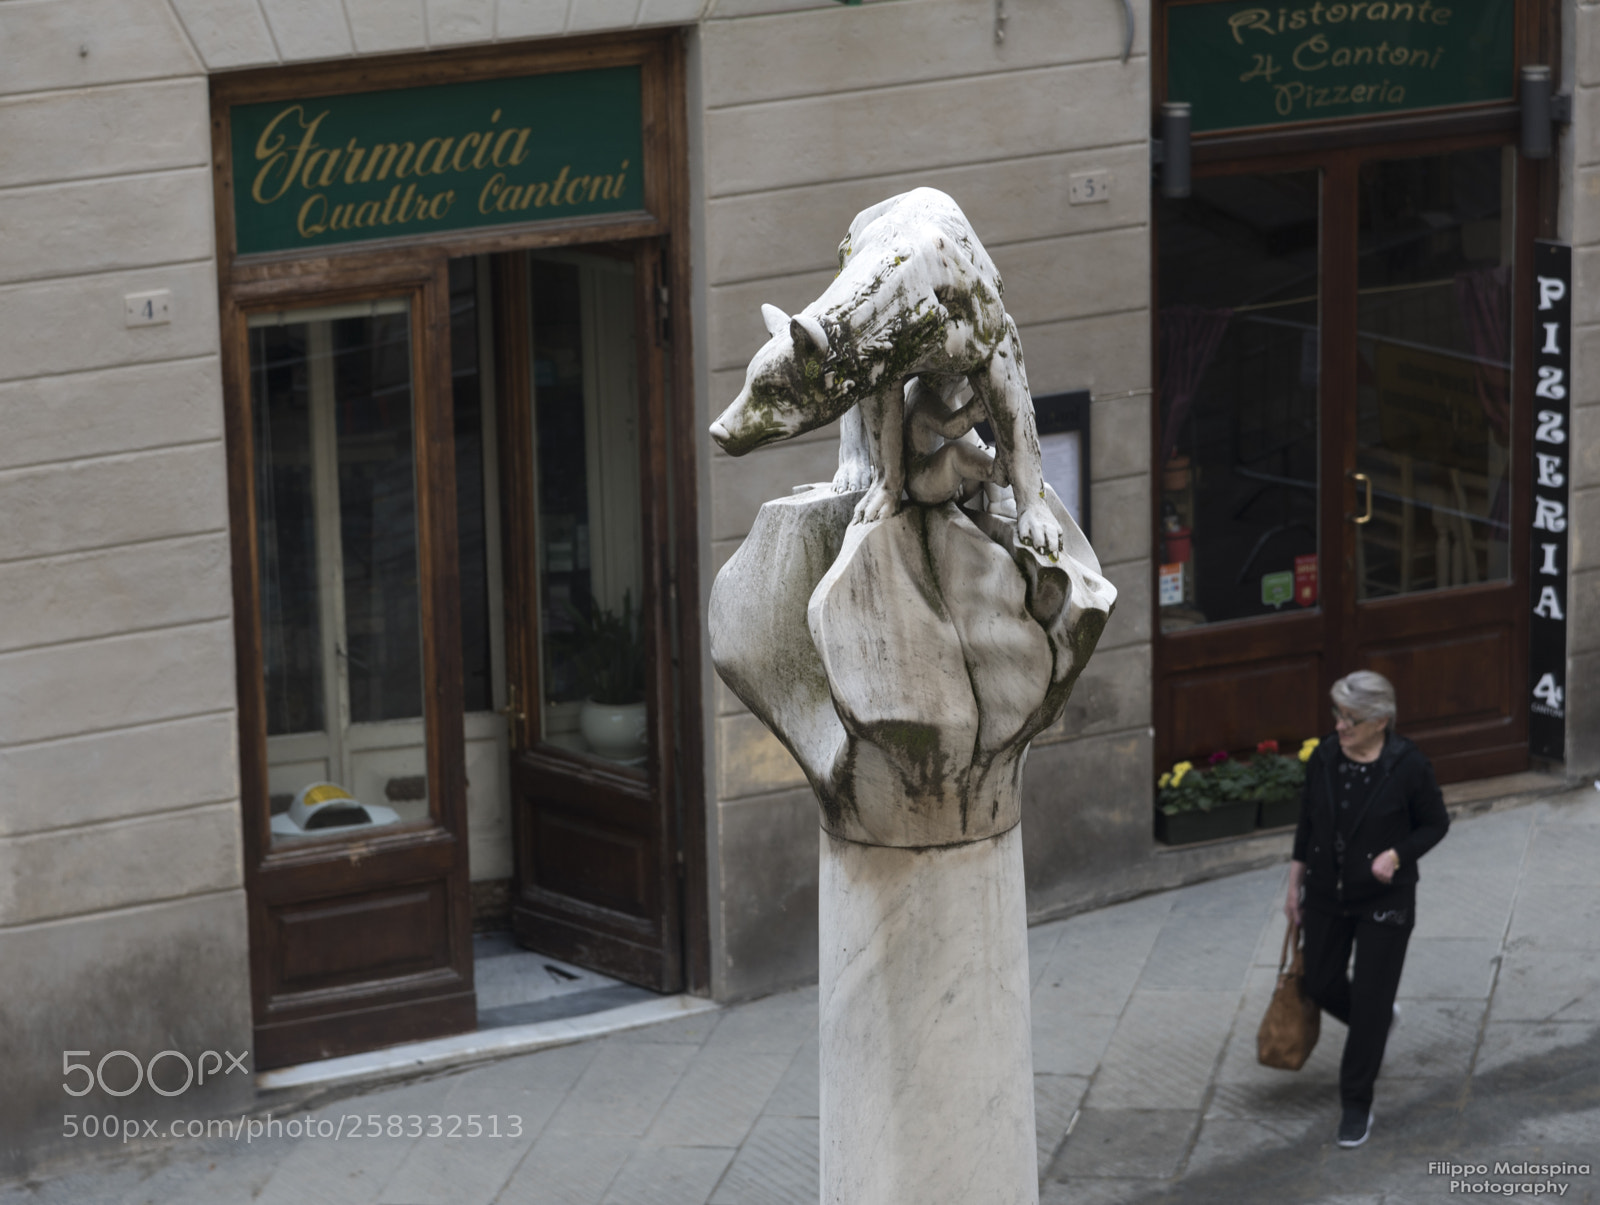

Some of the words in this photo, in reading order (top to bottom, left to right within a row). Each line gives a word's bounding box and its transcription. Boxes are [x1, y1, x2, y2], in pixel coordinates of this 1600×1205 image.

[1228, 0, 1452, 44] Ristorante
[1240, 54, 1281, 82] 4
[1293, 34, 1444, 71] Cantoni
[1274, 79, 1406, 116] Pizzeria
[252, 105, 532, 204] Farmacia
[297, 184, 455, 238] Quattro
[478, 160, 630, 215] Cantoni
[1085, 179, 1096, 198] 5
[1533, 275, 1567, 621] PIZZERIA
[1533, 673, 1563, 709] 4
